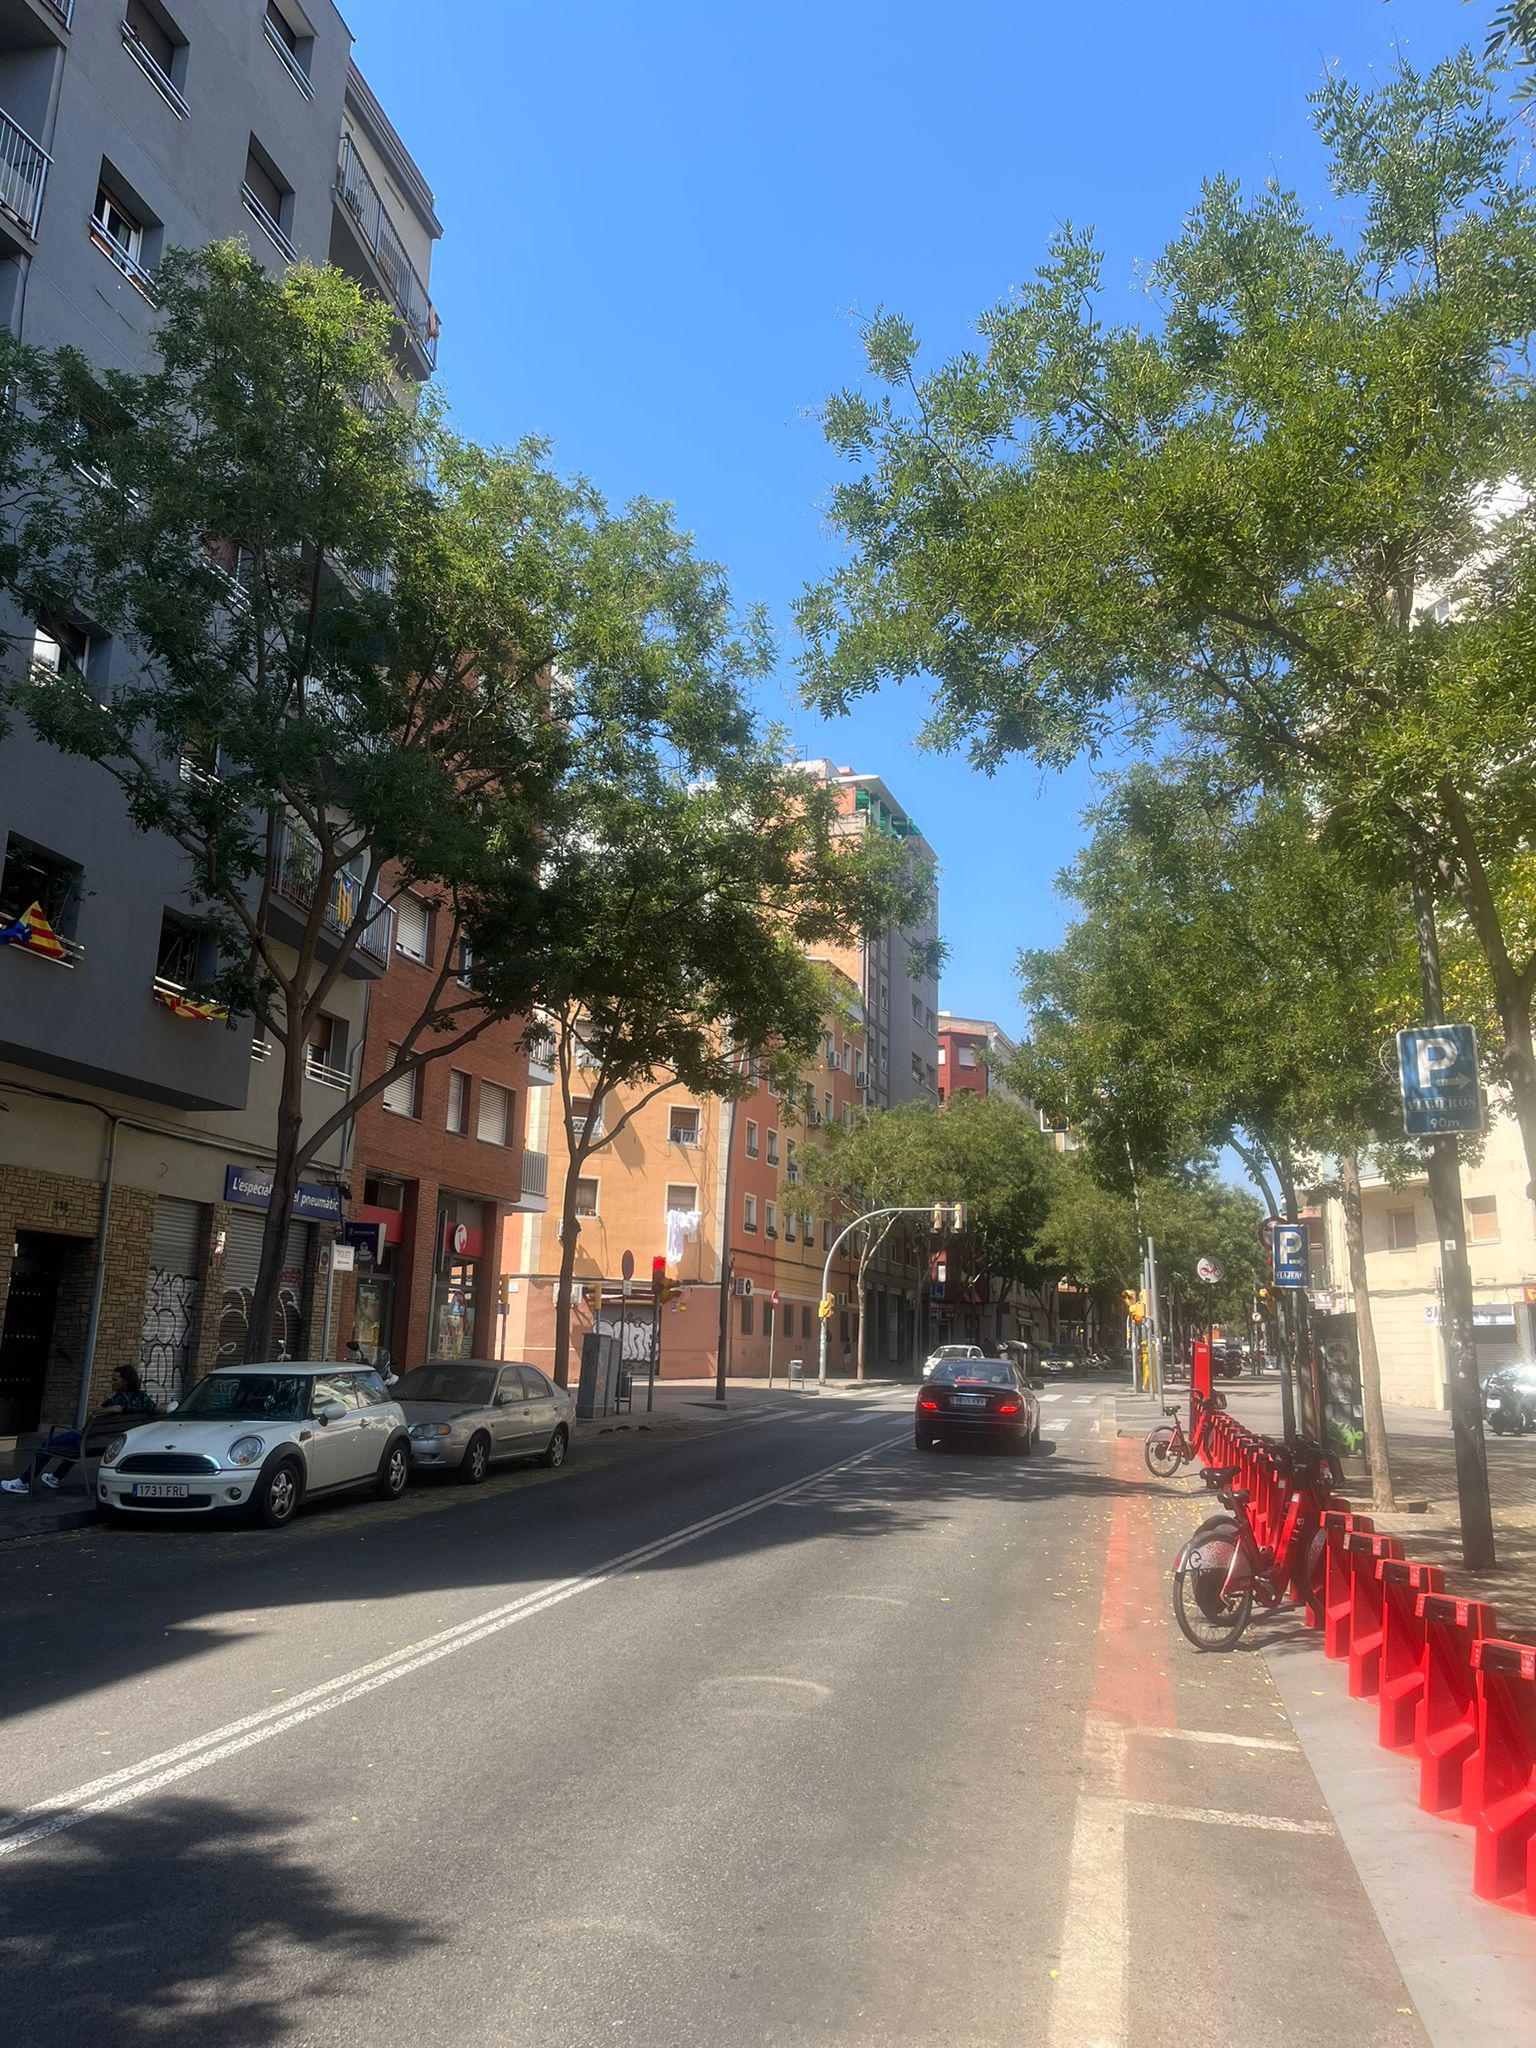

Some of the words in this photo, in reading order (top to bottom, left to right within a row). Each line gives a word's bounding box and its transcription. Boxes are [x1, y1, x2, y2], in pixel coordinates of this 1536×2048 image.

[1416, 1037, 1458, 1088] P
[1406, 1094, 1477, 1112] VIAJEROS
[1430, 1117, 1461, 1129] 90m
[1280, 1231, 1303, 1265] P
[140, 1485, 163, 1496] 1731
[166, 1485, 185, 1496] FRL
